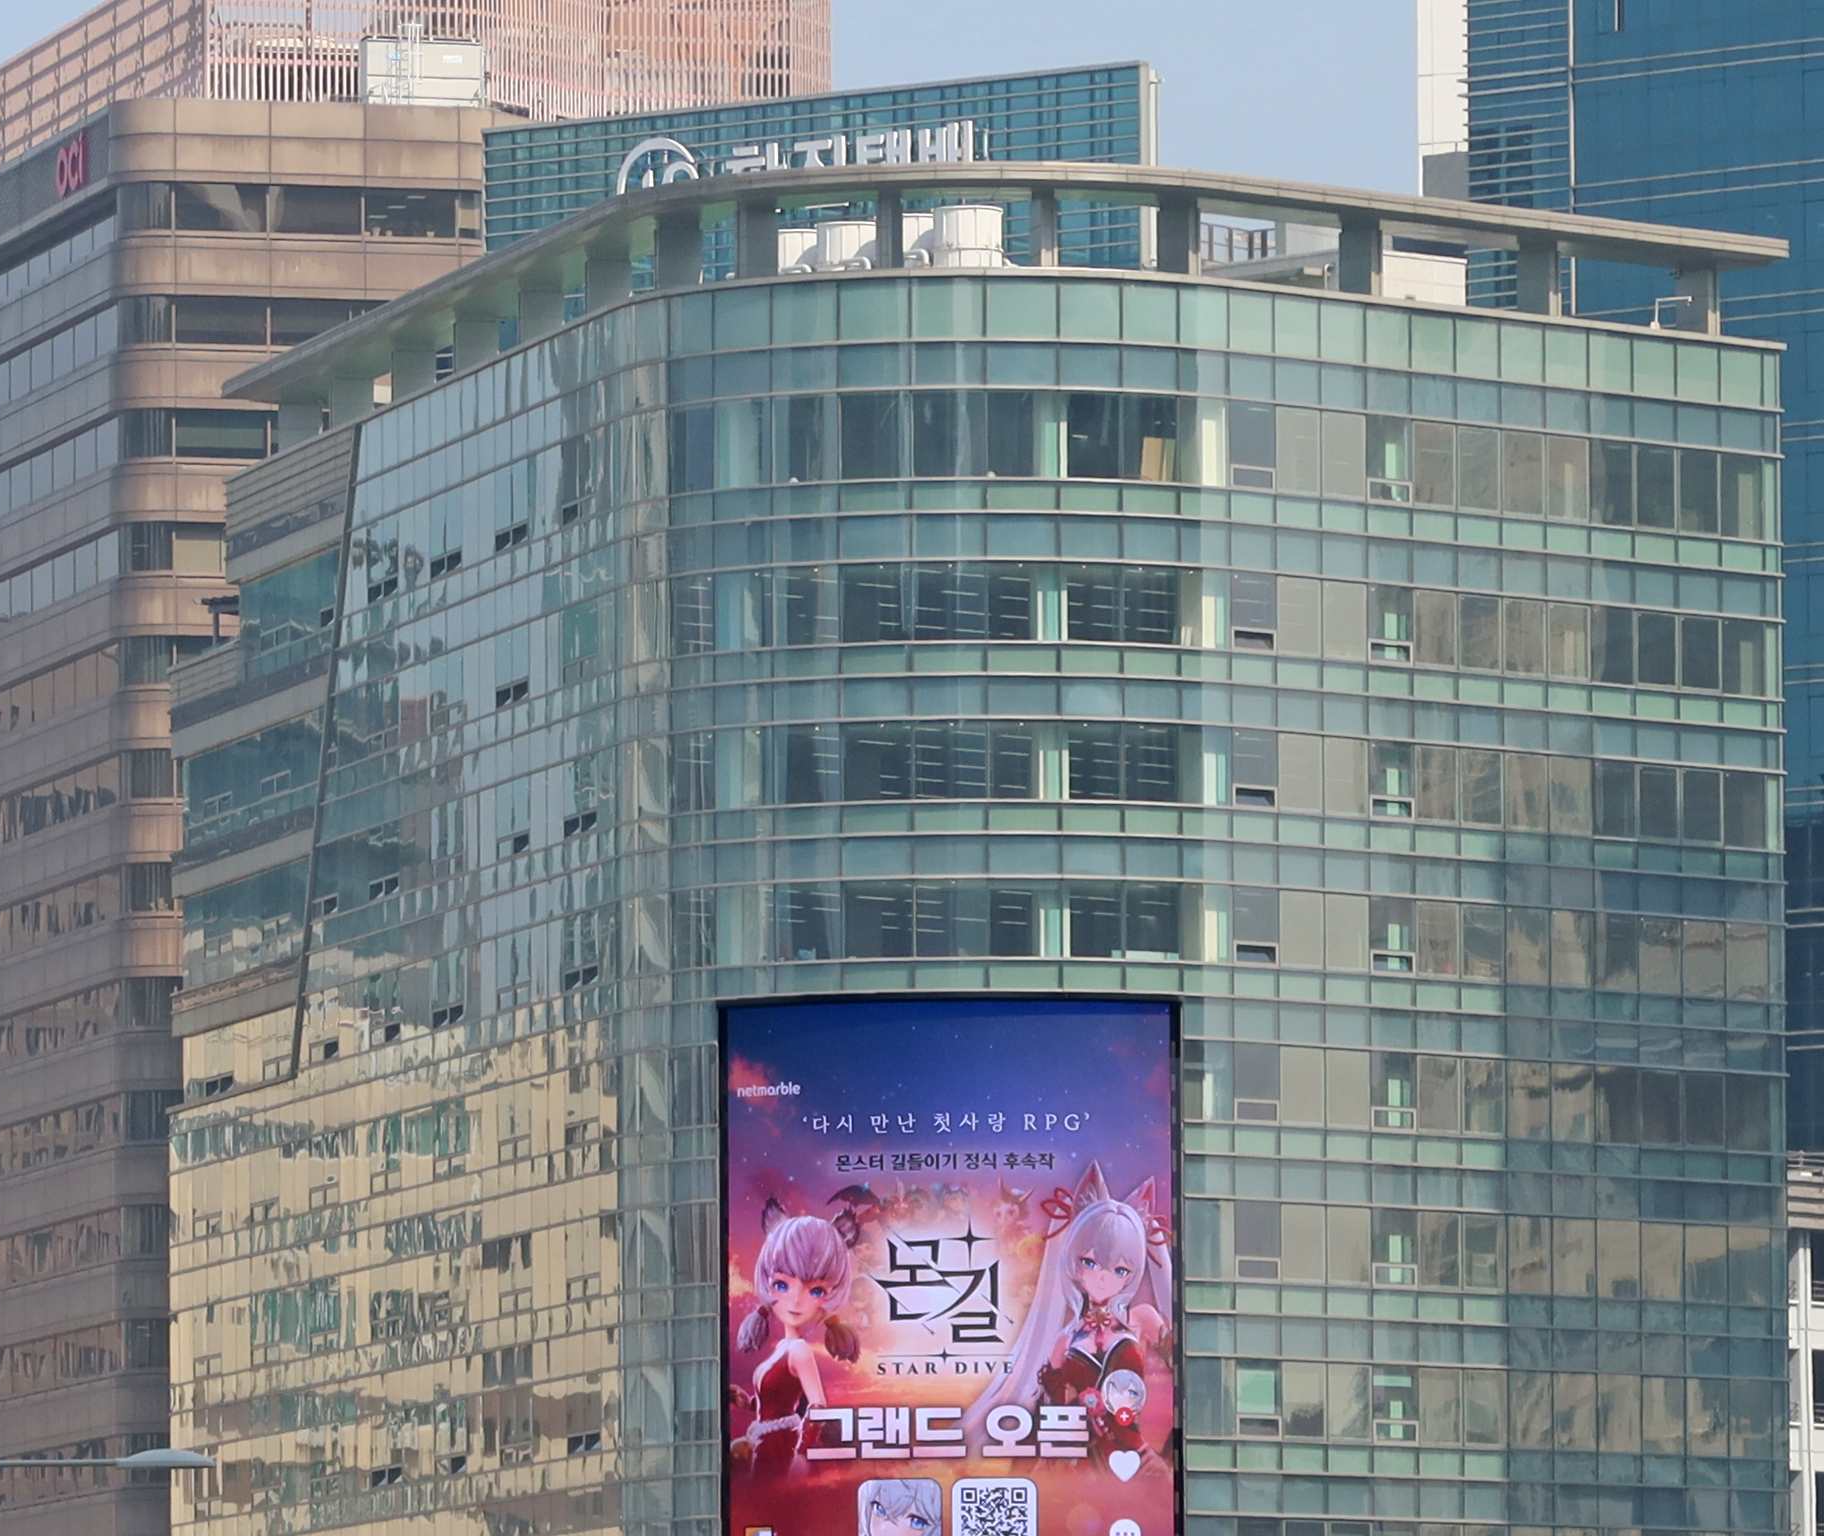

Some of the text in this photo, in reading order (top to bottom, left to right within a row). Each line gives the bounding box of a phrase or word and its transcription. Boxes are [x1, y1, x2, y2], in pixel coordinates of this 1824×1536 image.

[737, 1081, 801, 1098] netmarble
[871, 1113, 916, 1134] 만난
[934, 1111, 1007, 1134] 첫사랑
[835, 1152, 1055, 1172] 몬스터 길들이기 정식 후속작
[873, 1230, 1009, 1345] 몬길
[876, 1361, 1014, 1376] STAR DIVE
[806, 1404, 1090, 1461] 그랜드 오픈
